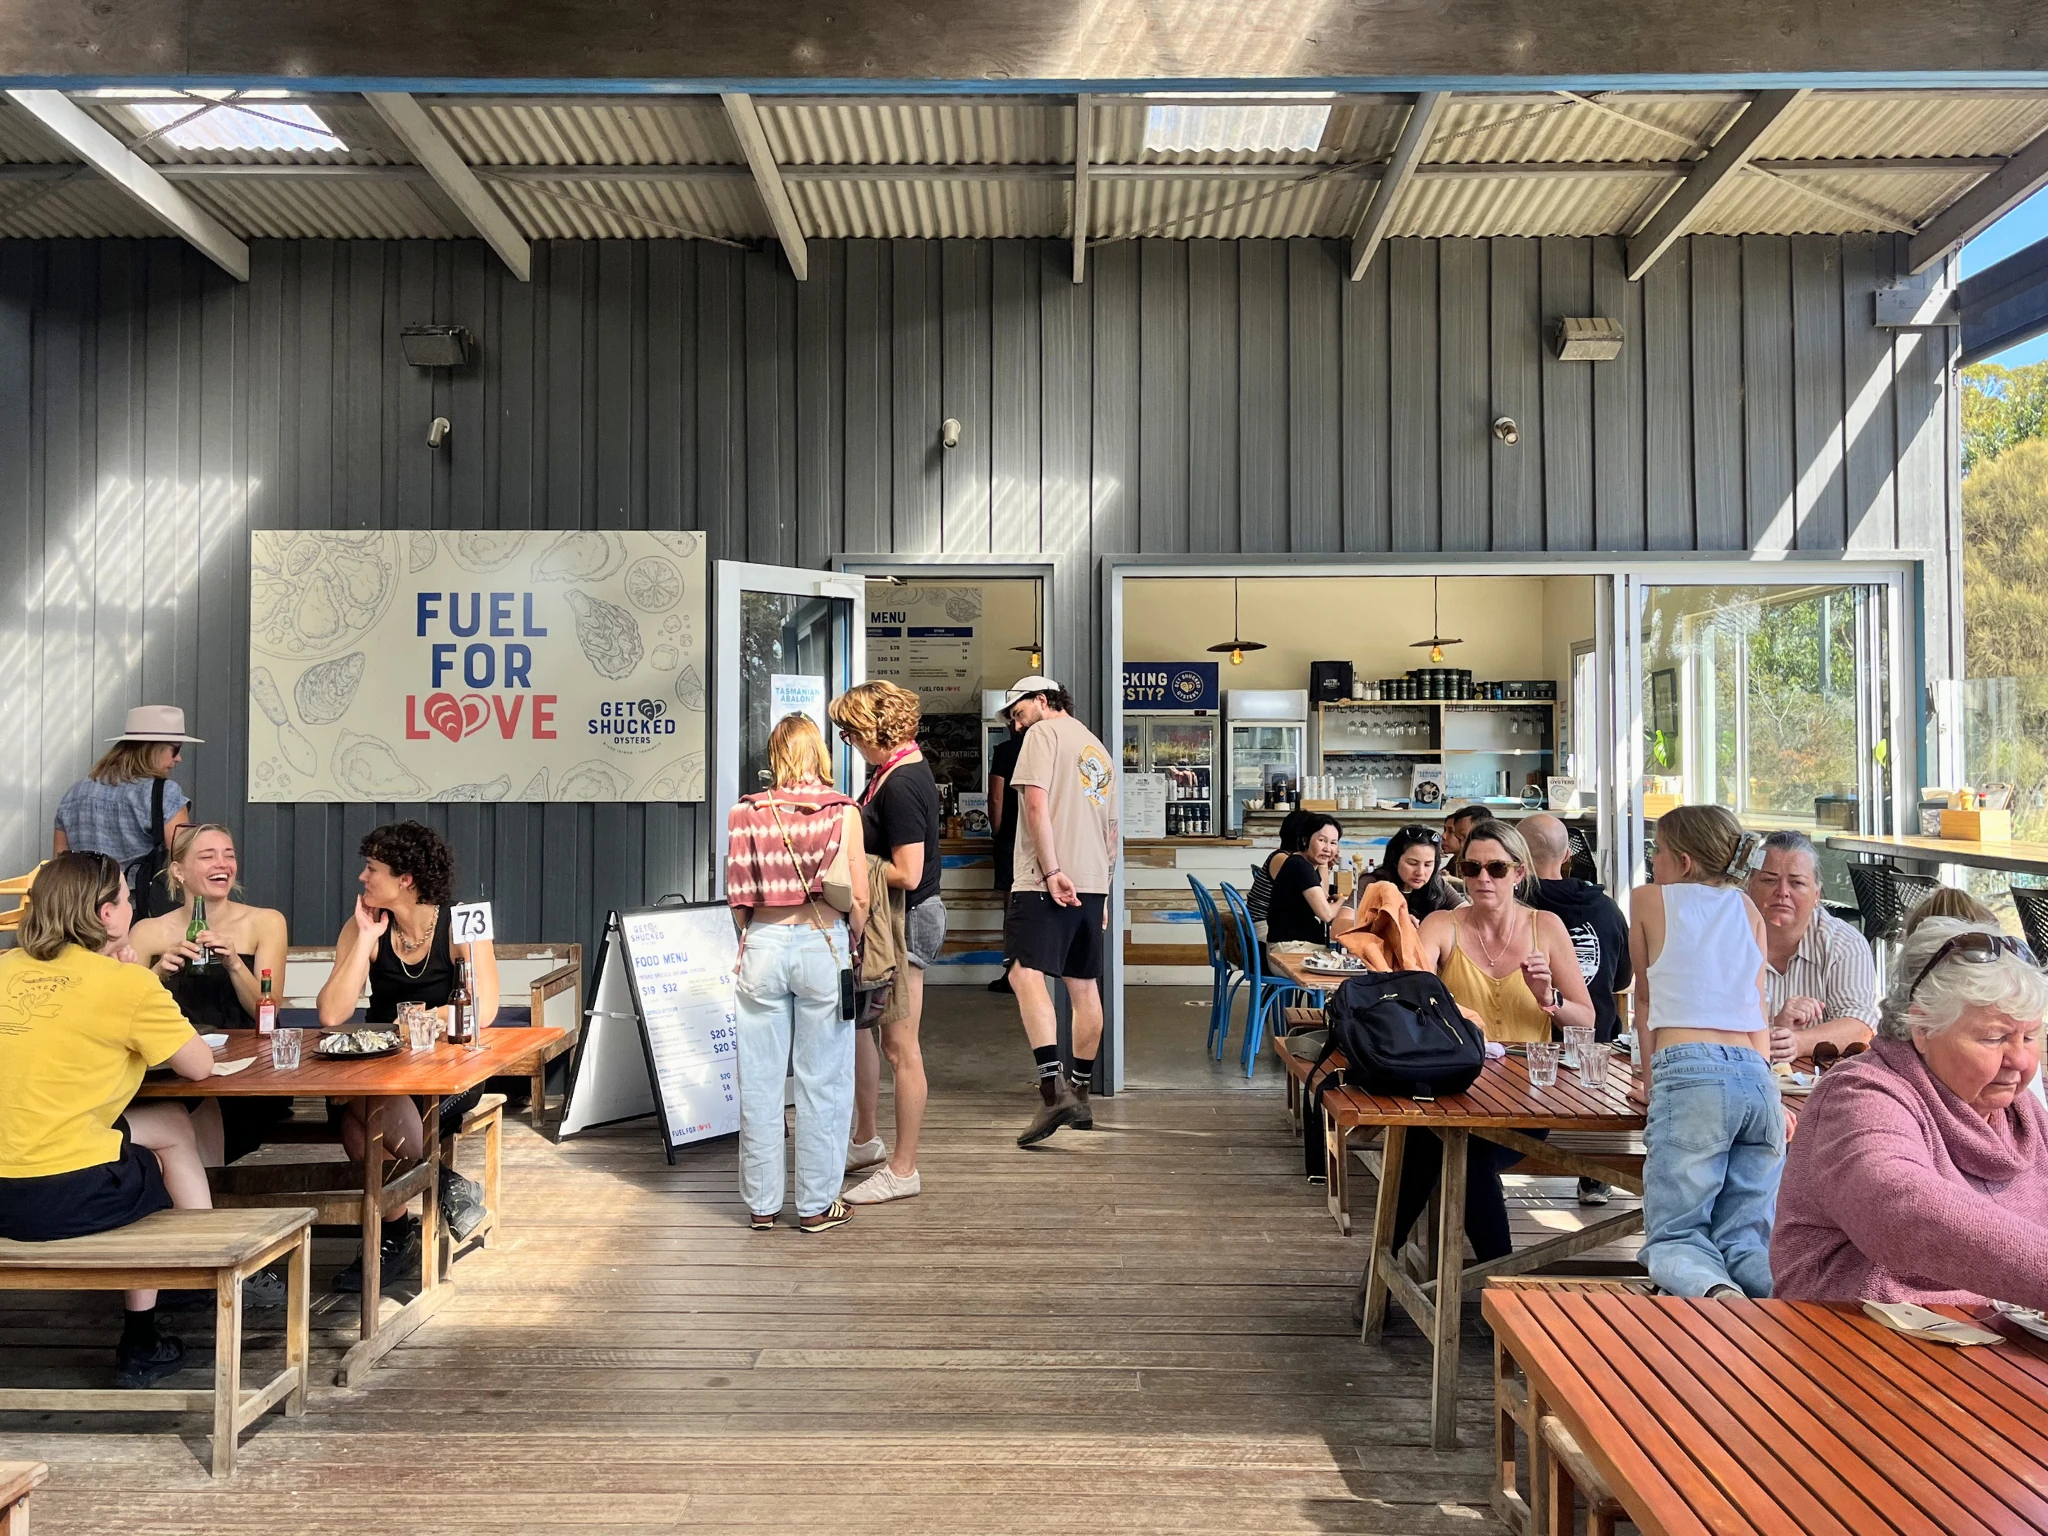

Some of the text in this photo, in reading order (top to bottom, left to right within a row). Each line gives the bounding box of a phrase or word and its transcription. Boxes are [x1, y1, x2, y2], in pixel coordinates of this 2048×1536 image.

[416, 592, 547, 637] FUEL
[870, 612, 906, 624] MENU
[431, 644, 532, 688] FOR
[775, 687, 820, 695] TASMANIAN
[1123, 688, 1164, 701] STY?
[600, 702, 636, 717] GET
[405, 692, 558, 743] LOVE
[588, 719, 676, 734] SHUCKED
[457, 910, 486, 936] 73
[633, 925, 648, 933] GET
[631, 932, 664, 942] SHUCKED
[635, 952, 688, 968] FOOD MENU
[642, 986, 656, 996] $19
[662, 983, 678, 993] $32
[720, 975, 730, 984] $5
[710, 1029, 726, 1040] $20
[714, 1043, 729, 1054] $20
[720, 1072, 730, 1080] $20
[672, 1123, 712, 1137] FUEL FOR LOVE
